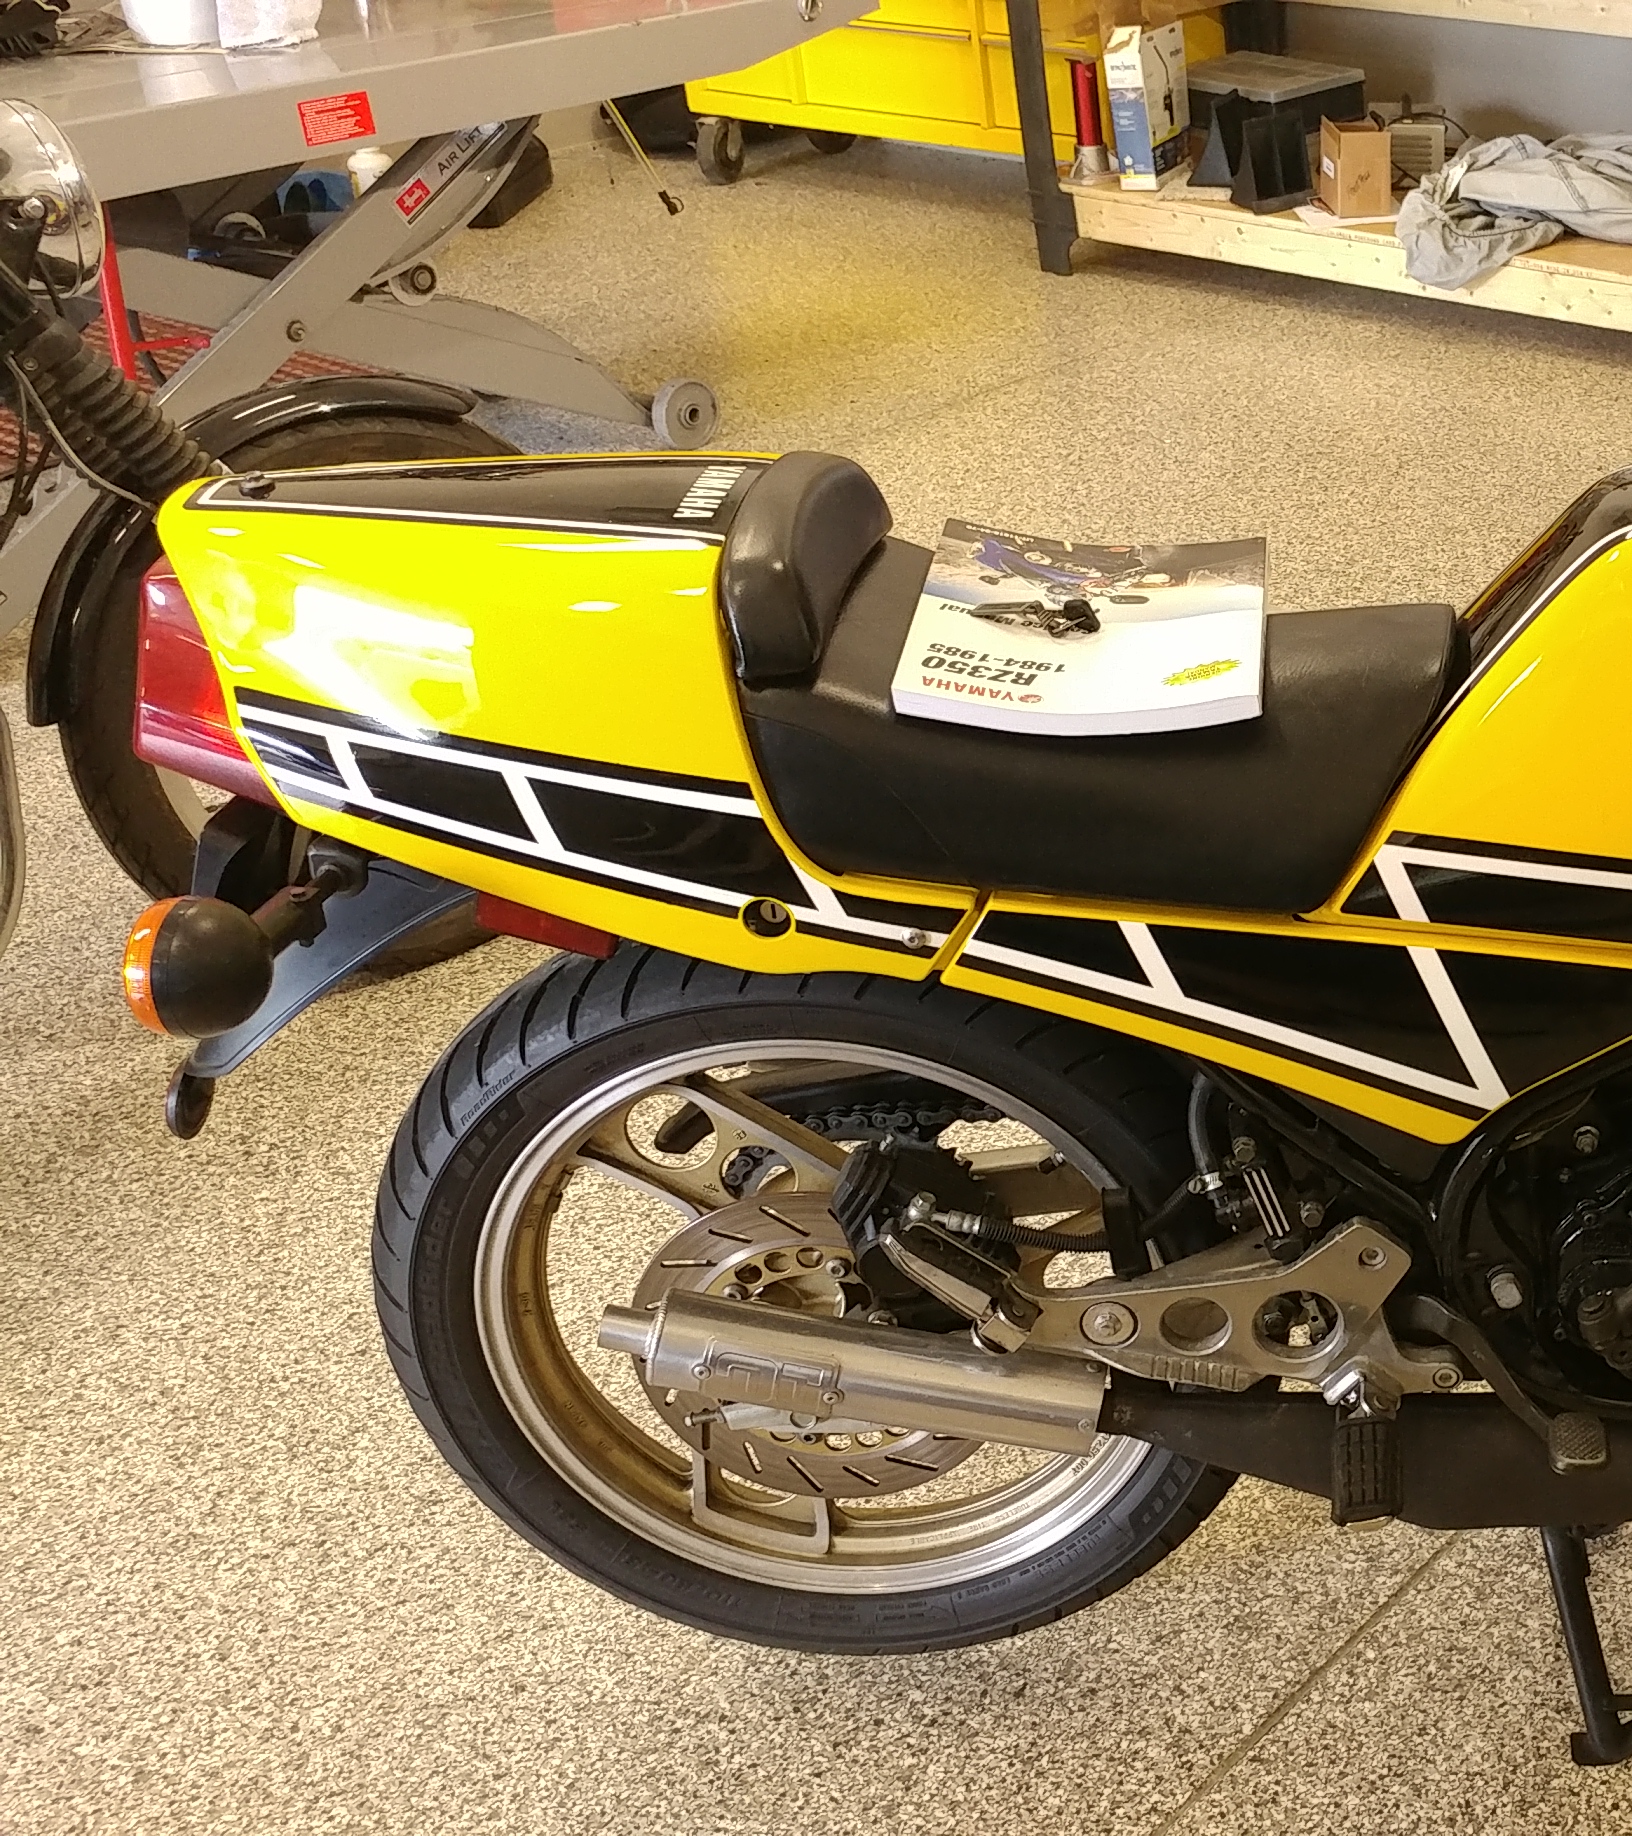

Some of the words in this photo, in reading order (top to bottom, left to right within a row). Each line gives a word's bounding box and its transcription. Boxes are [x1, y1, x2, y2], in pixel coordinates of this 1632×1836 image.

[437, 151, 460, 176] AIR
[456, 126, 484, 154] LIFT
[672, 465, 748, 518] YAMAHA
[921, 656, 1038, 686] RZ350
[927, 643, 1066, 673] 1984-1985
[922, 675, 1014, 702] YAMAHA
